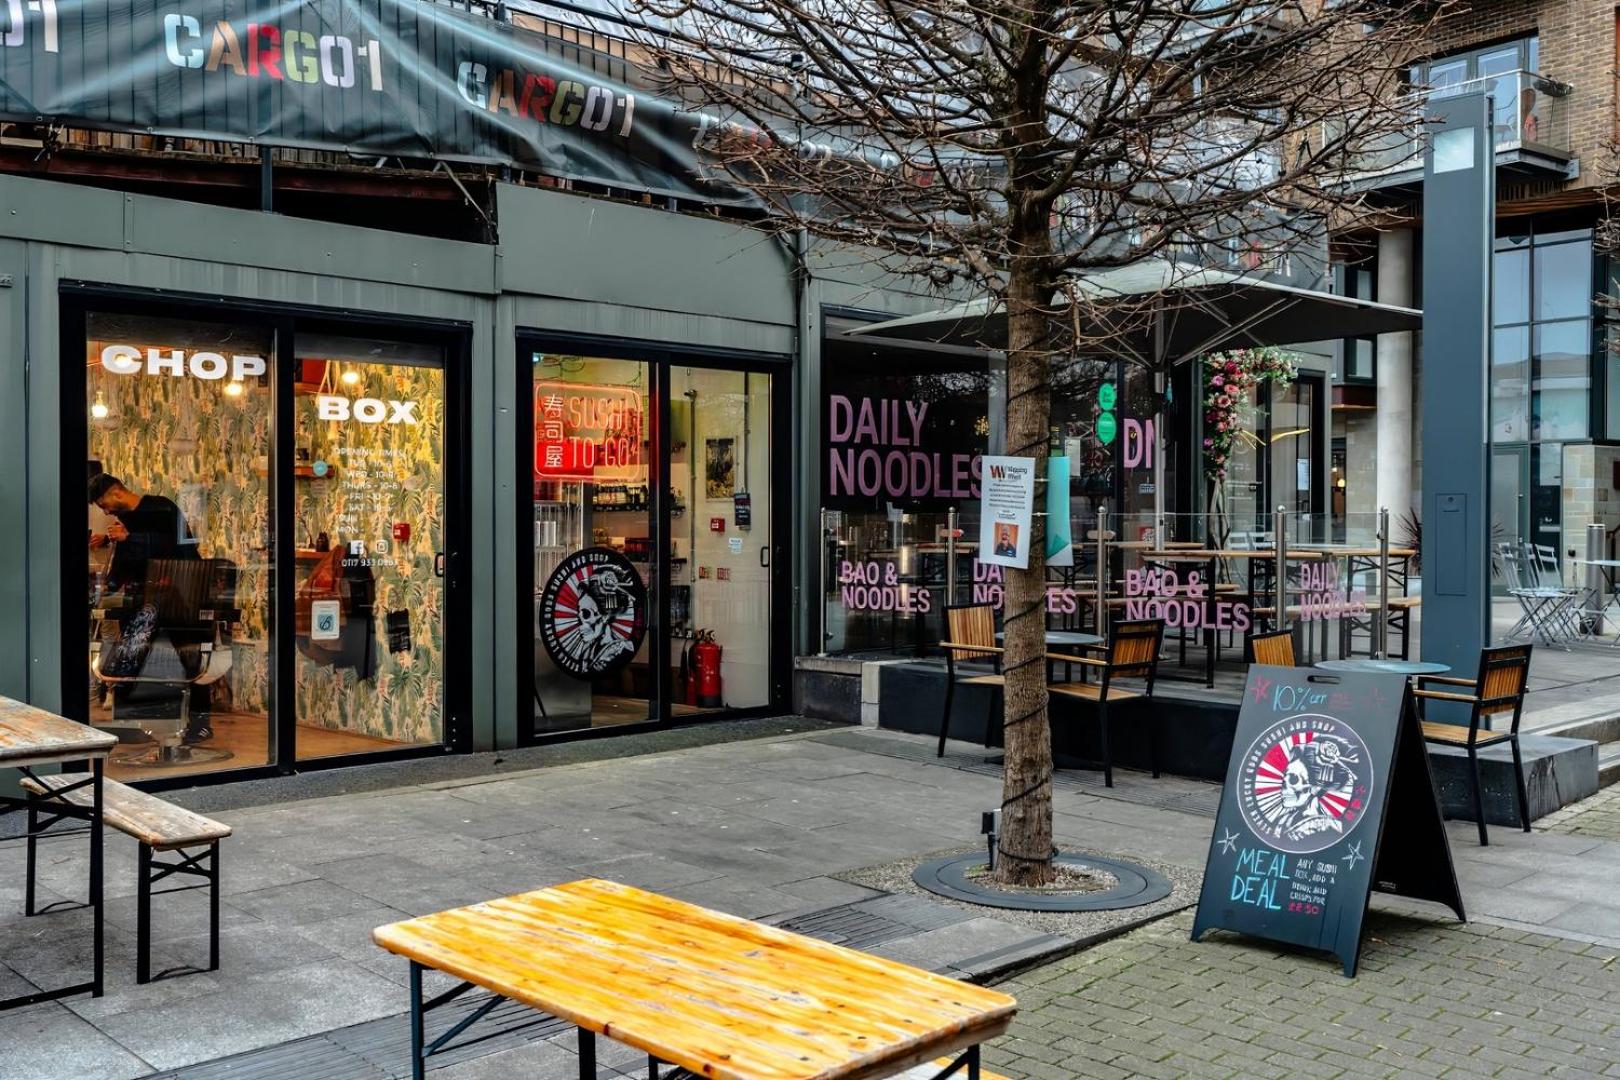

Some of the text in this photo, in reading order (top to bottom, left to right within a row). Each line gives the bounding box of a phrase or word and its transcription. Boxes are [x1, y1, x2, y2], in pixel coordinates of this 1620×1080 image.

[101, 345, 266, 380] CHOP
[318, 396, 417, 425] BOX
[569, 396, 629, 431] SUSHI
[830, 394, 929, 447] DAILY
[544, 394, 564, 468] 寿司屋
[569, 436, 629, 469] TO GO
[842, 561, 898, 586] BAO &
[1126, 569, 1204, 598] BAO &
[841, 585, 931, 613] NOODLES
[1126, 599, 1250, 632] NOODLES
[1272, 685, 1310, 711] 10%
[1261, 727, 1286, 749] SUSHI
[1289, 721, 1307, 732] AND
[1312, 720, 1335, 733] SHOP
[1236, 848, 1290, 879] MEAL
[1297, 858, 1313, 869] ANY
[1231, 875, 1281, 909] DEAL
